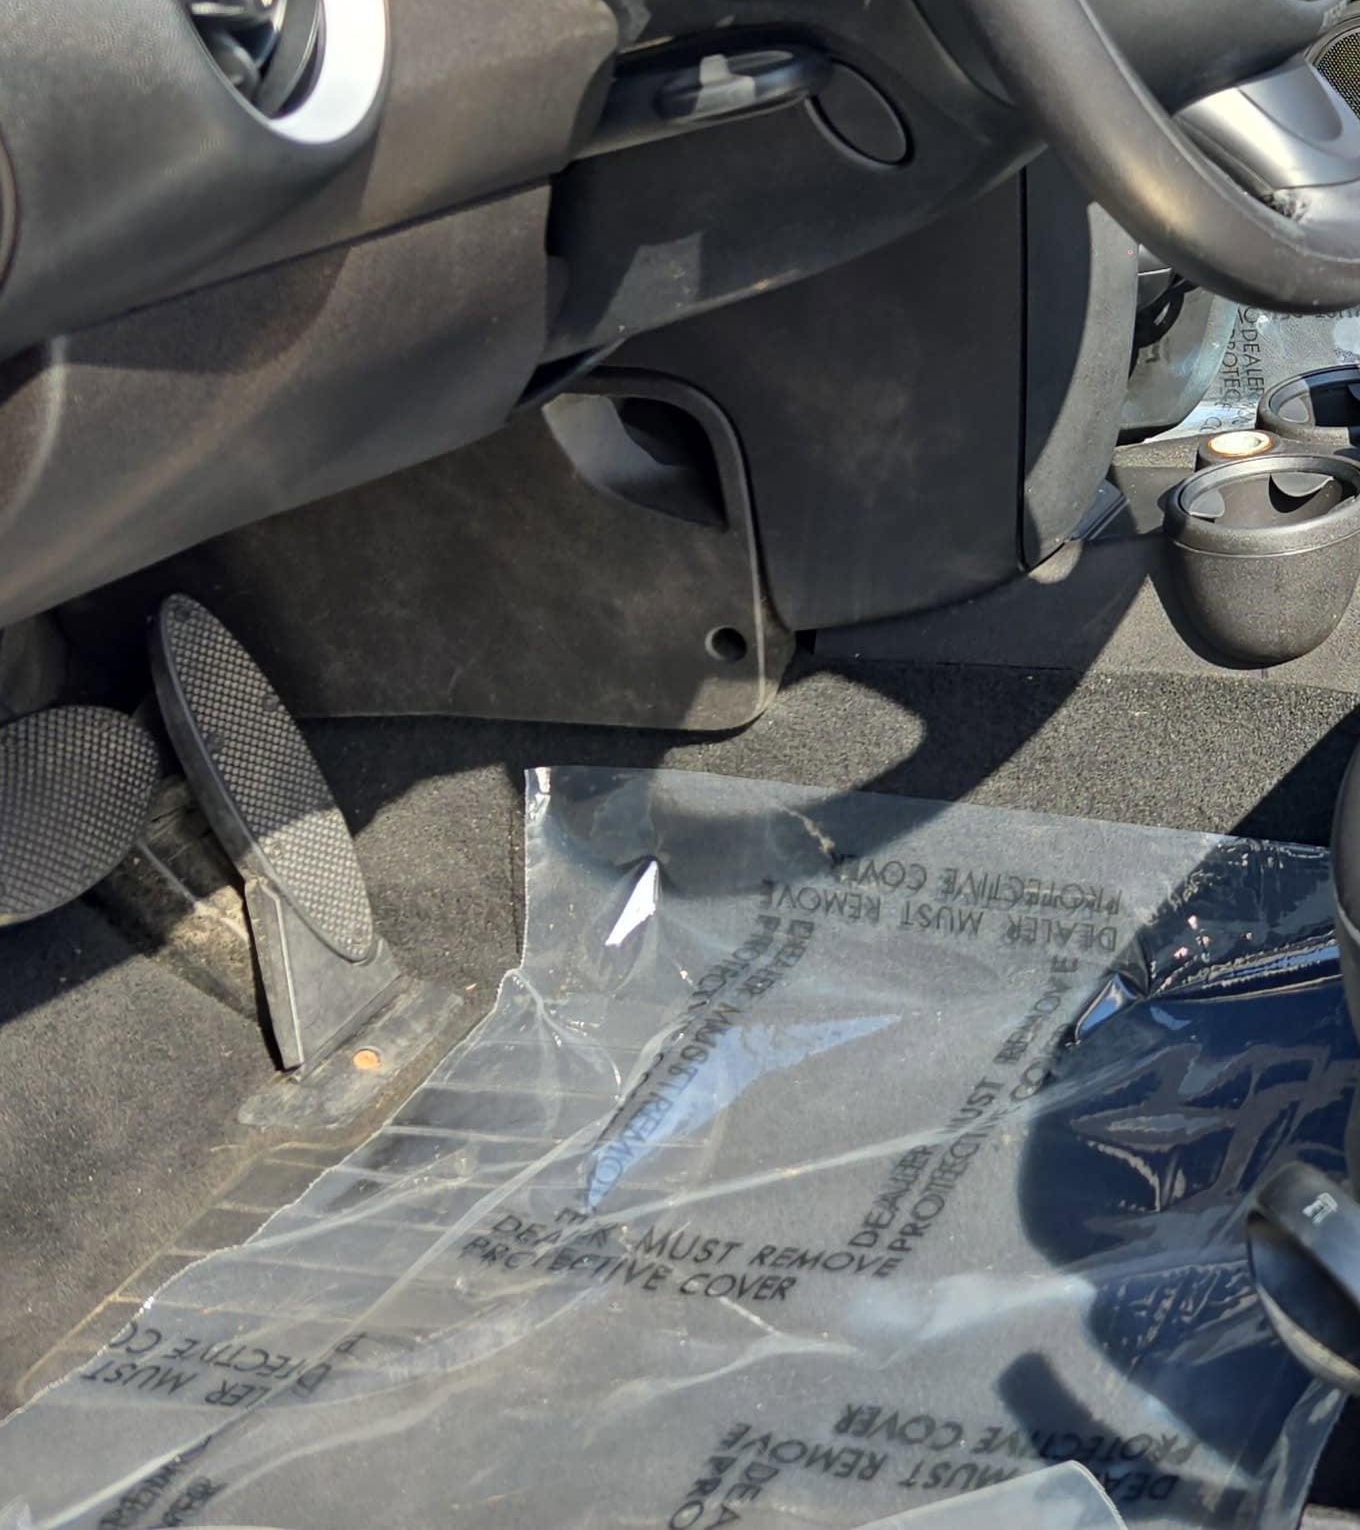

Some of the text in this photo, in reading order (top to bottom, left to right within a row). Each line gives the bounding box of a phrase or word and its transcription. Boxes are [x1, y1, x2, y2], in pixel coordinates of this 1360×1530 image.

[759, 877, 1119, 952] DEALER MUST REMOVE
[936, 867, 1123, 920] PROTECTIVE
[629, 1226, 747, 1265] MUST
[749, 1244, 904, 1279] REMOVE
[678, 1272, 798, 1302] COVER
[79, 1359, 198, 1395] MUST
[714, 1422, 888, 1482] REMOVE
[832, 1402, 963, 1452] COVER
[897, 1459, 1022, 1491] MUST
